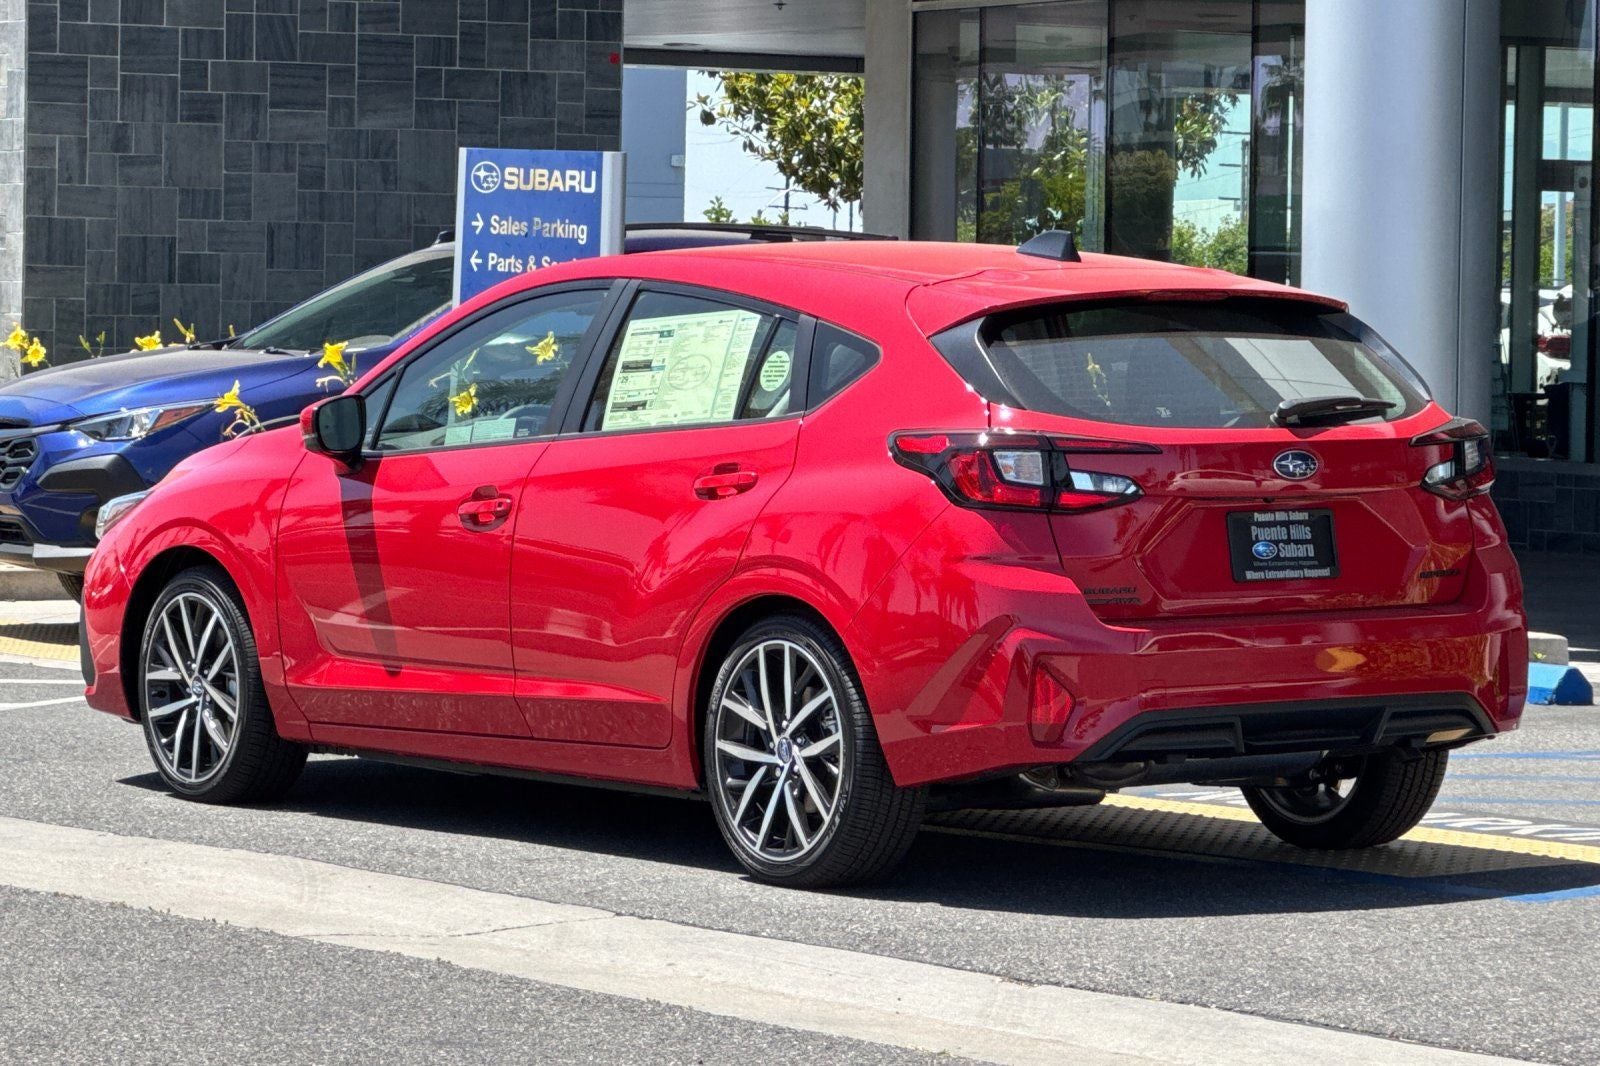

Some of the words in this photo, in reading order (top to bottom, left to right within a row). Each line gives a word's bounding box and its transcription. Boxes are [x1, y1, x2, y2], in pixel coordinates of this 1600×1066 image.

[504, 167, 596, 193] SUBARU
[490, 215, 528, 235] Sales
[532, 217, 588, 245] Parking
[488, 252, 522, 273] Parts
[527, 255, 537, 272] &
[1254, 512, 1275, 522] Puente
[1289, 511, 1309, 520] Subaru
[1251, 525, 1288, 540] Puente
[1289, 524, 1312, 540] Hills
[1278, 543, 1314, 557] Subaru
[1246, 571, 1265, 579] Where
